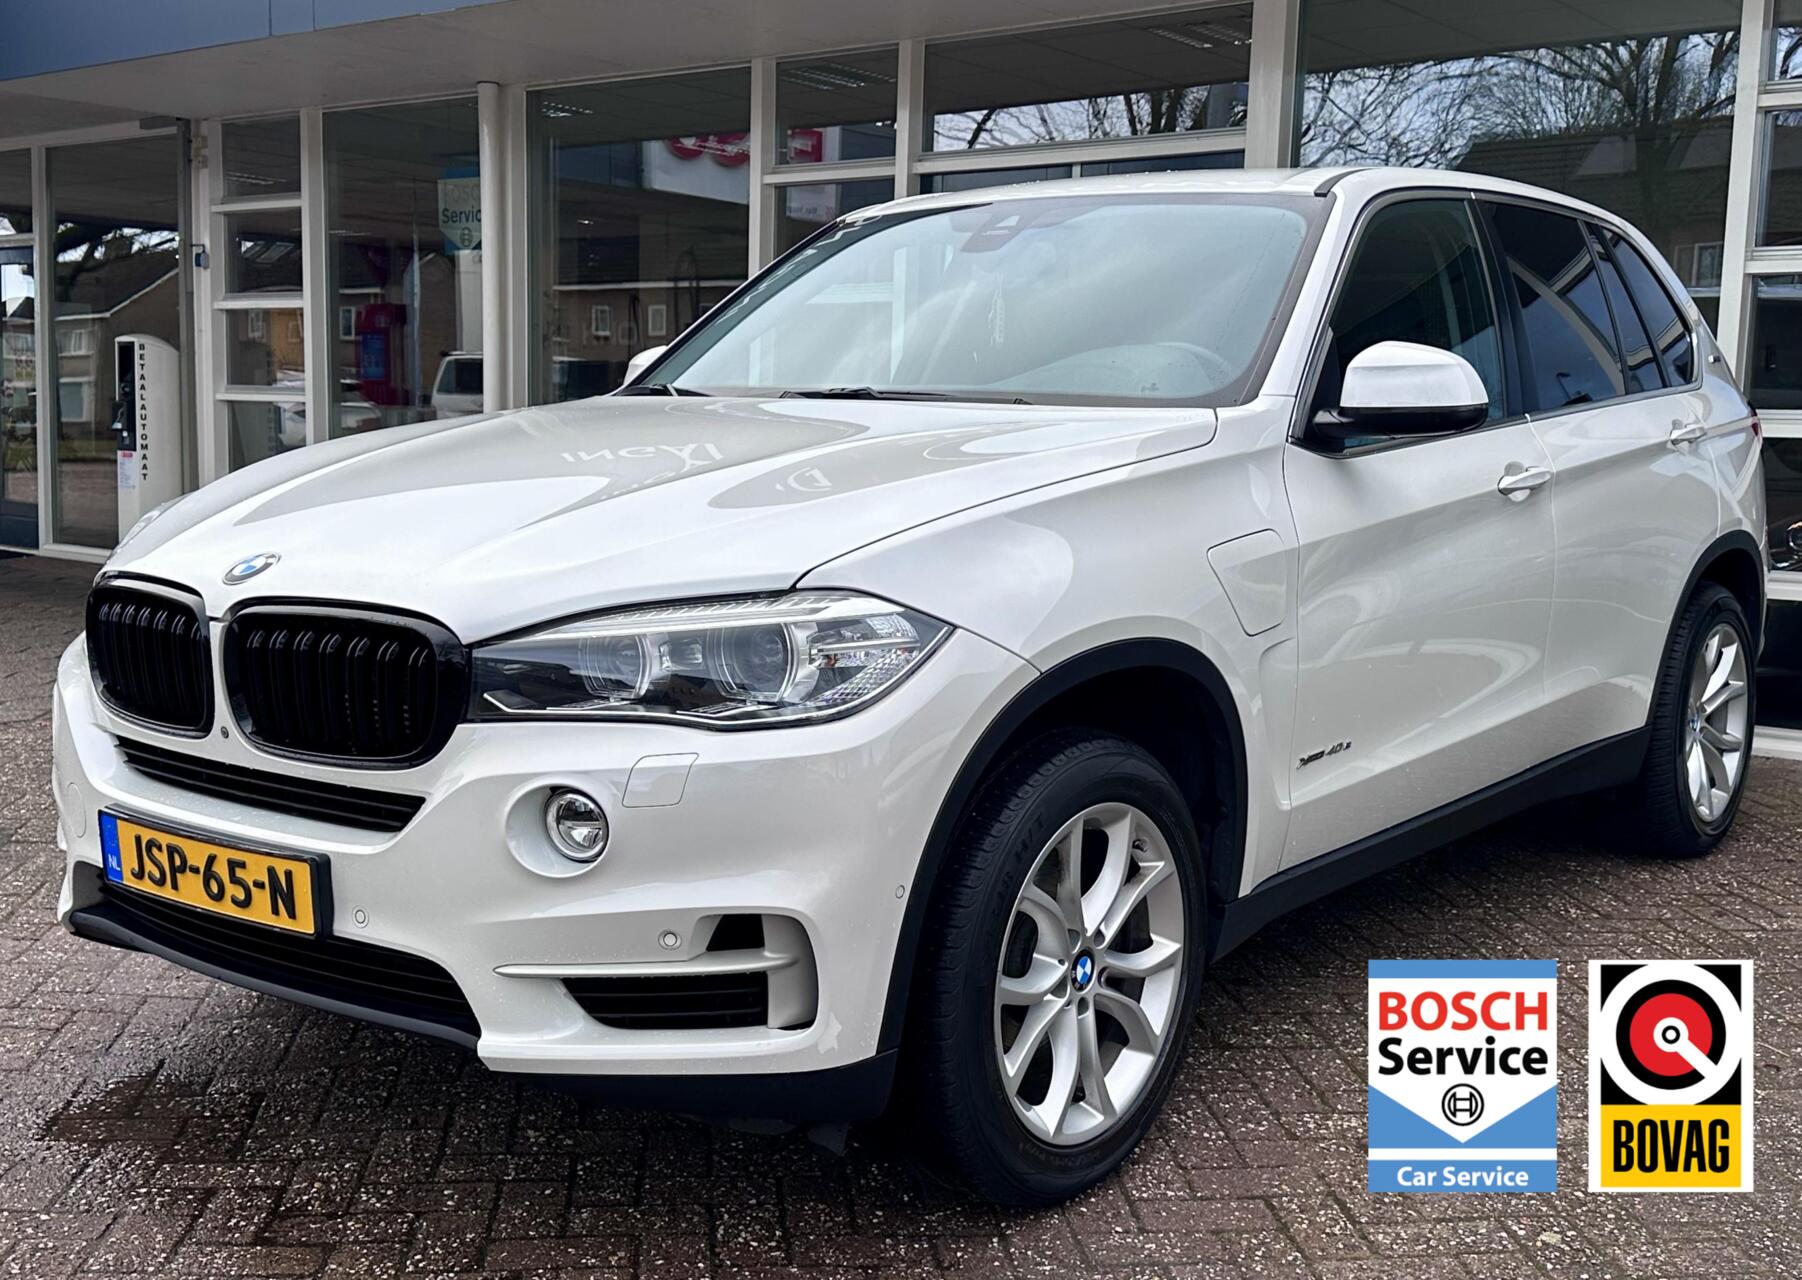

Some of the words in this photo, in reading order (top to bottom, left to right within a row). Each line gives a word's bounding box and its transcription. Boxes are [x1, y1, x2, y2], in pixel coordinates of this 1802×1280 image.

[442, 205, 482, 224] Servic
[138, 343, 149, 481] BETAALAUTOMAAT
[107, 853, 121, 872] NL
[130, 833, 297, 921] JSP-65-N
